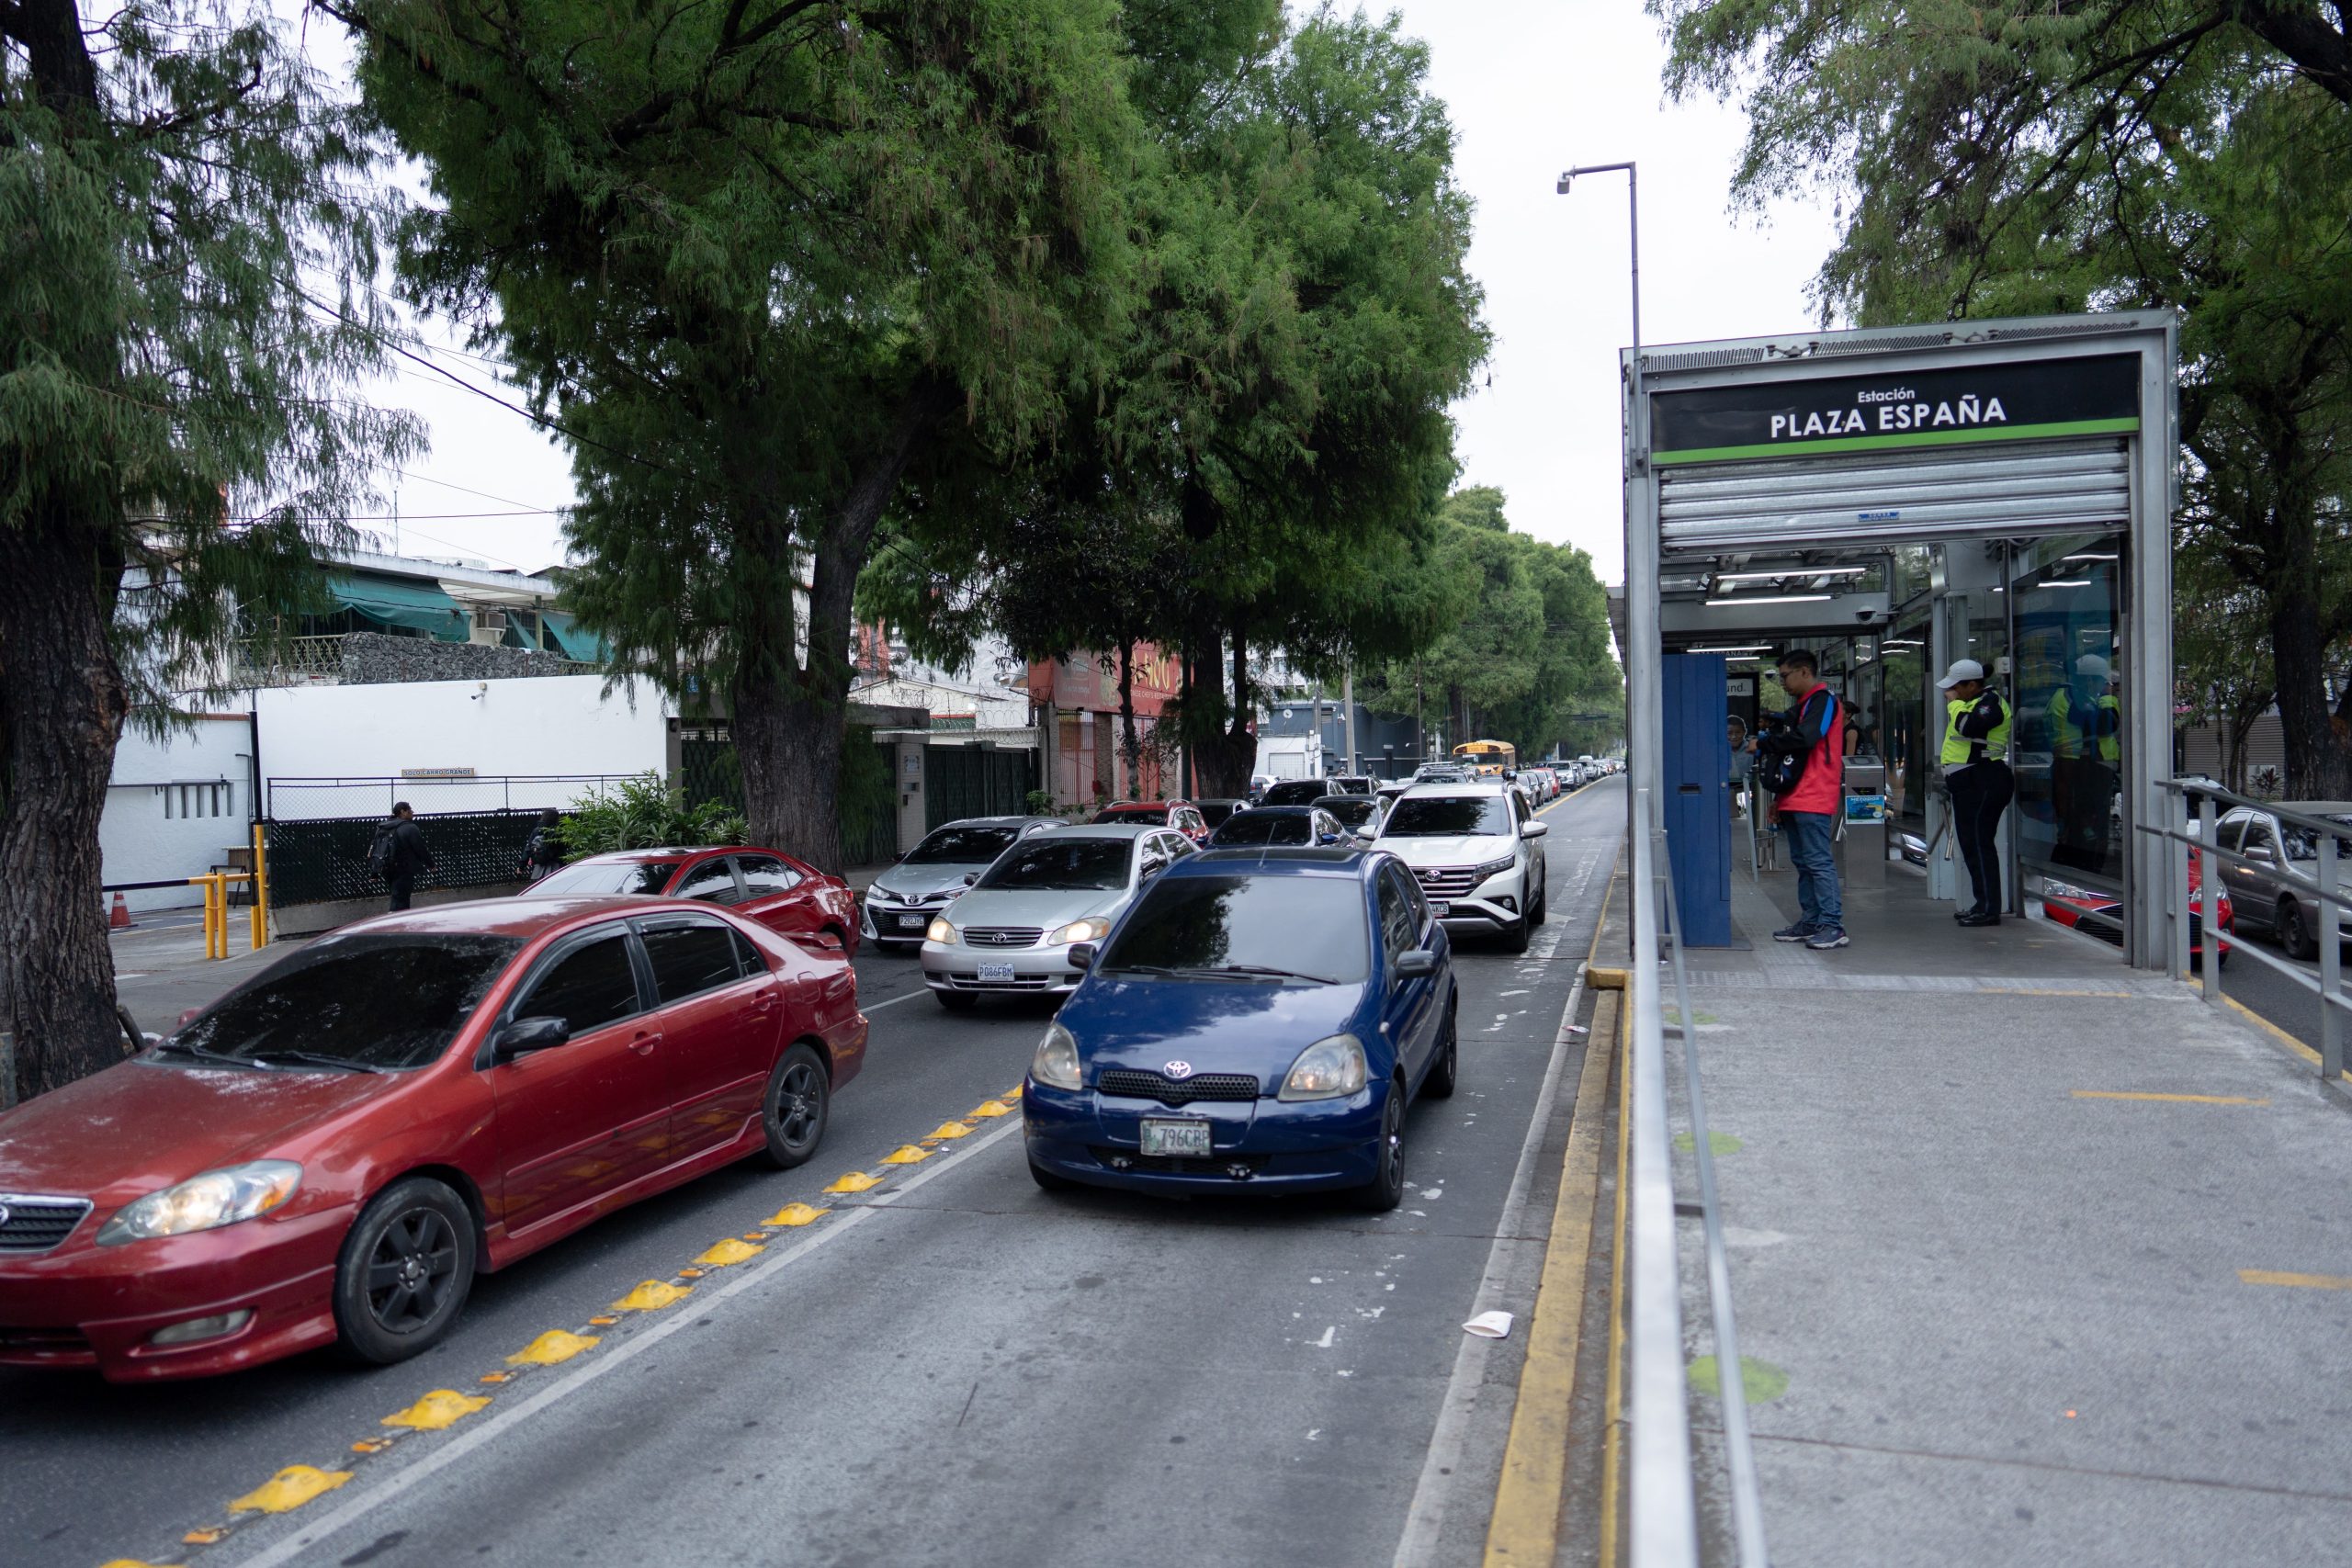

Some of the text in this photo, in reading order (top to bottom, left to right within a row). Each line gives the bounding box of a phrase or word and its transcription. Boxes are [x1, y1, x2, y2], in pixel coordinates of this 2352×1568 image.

[1858, 387, 1916, 403] Estación
[1770, 394, 2007, 438] PLAZA ESPAÑA
